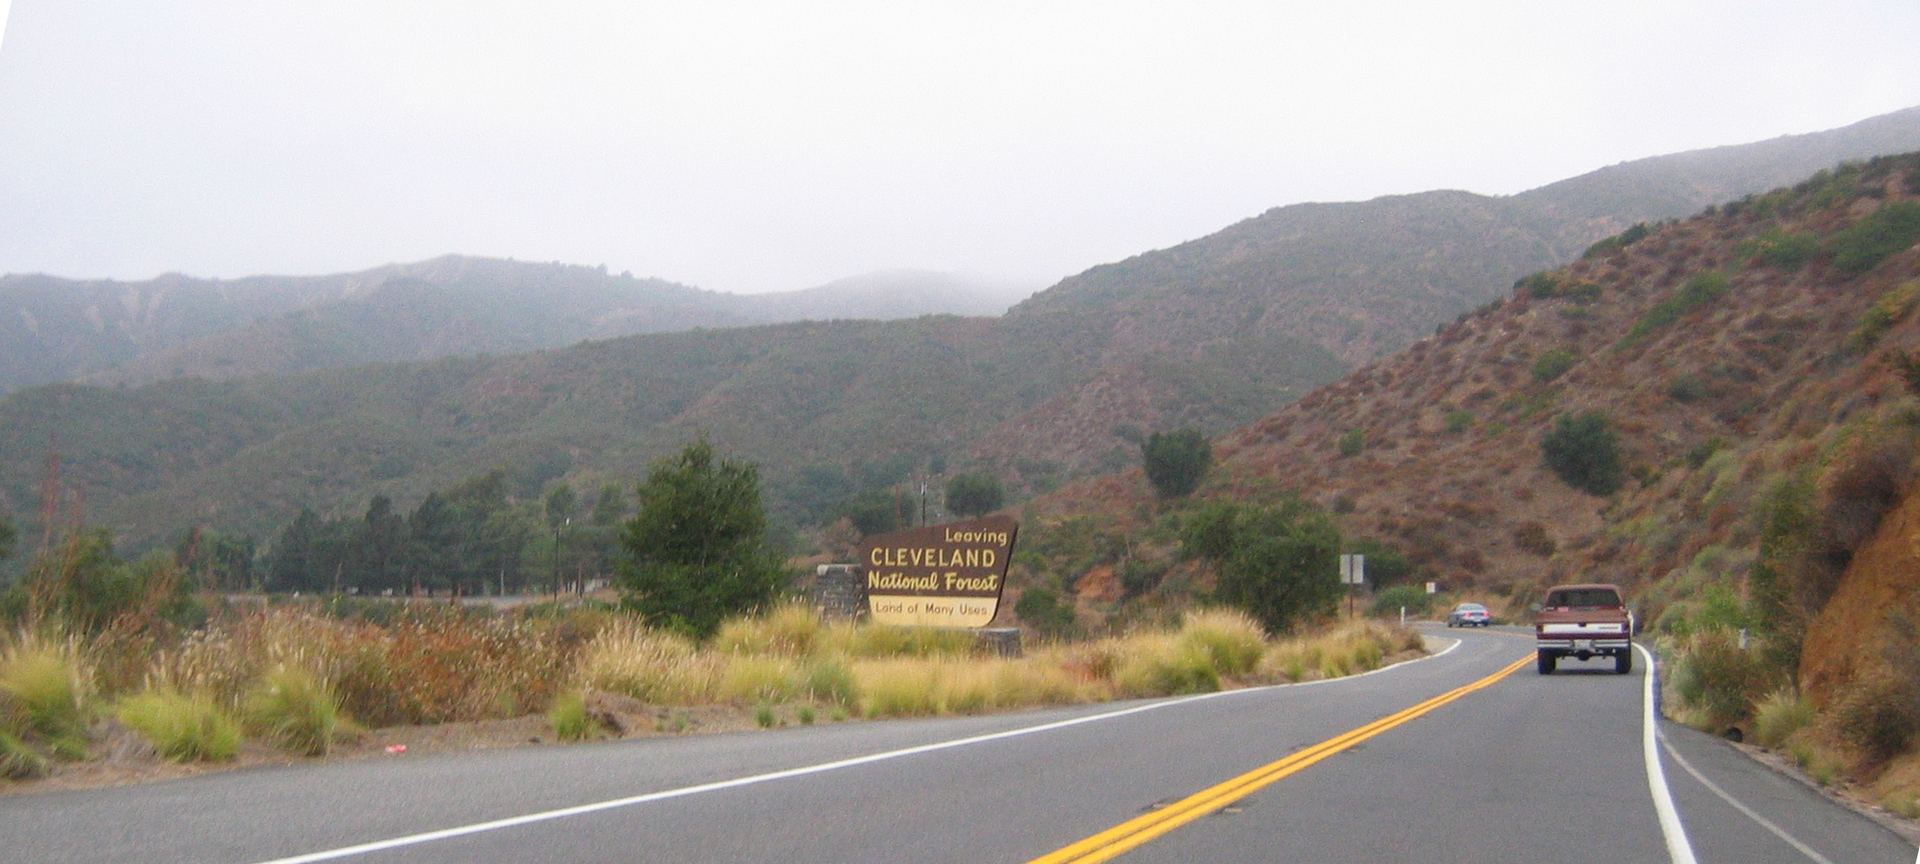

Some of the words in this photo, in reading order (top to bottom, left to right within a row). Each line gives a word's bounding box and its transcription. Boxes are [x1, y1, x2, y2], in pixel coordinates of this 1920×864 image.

[945, 528, 1008, 547] Leaving
[871, 548, 996, 568] CLEVELAND
[868, 570, 940, 592] National
[944, 572, 998, 592] Forest
[875, 602, 903, 614] Land
[907, 603, 918, 615] of
[925, 604, 954, 616] Many
[959, 604, 988, 616] Uses
